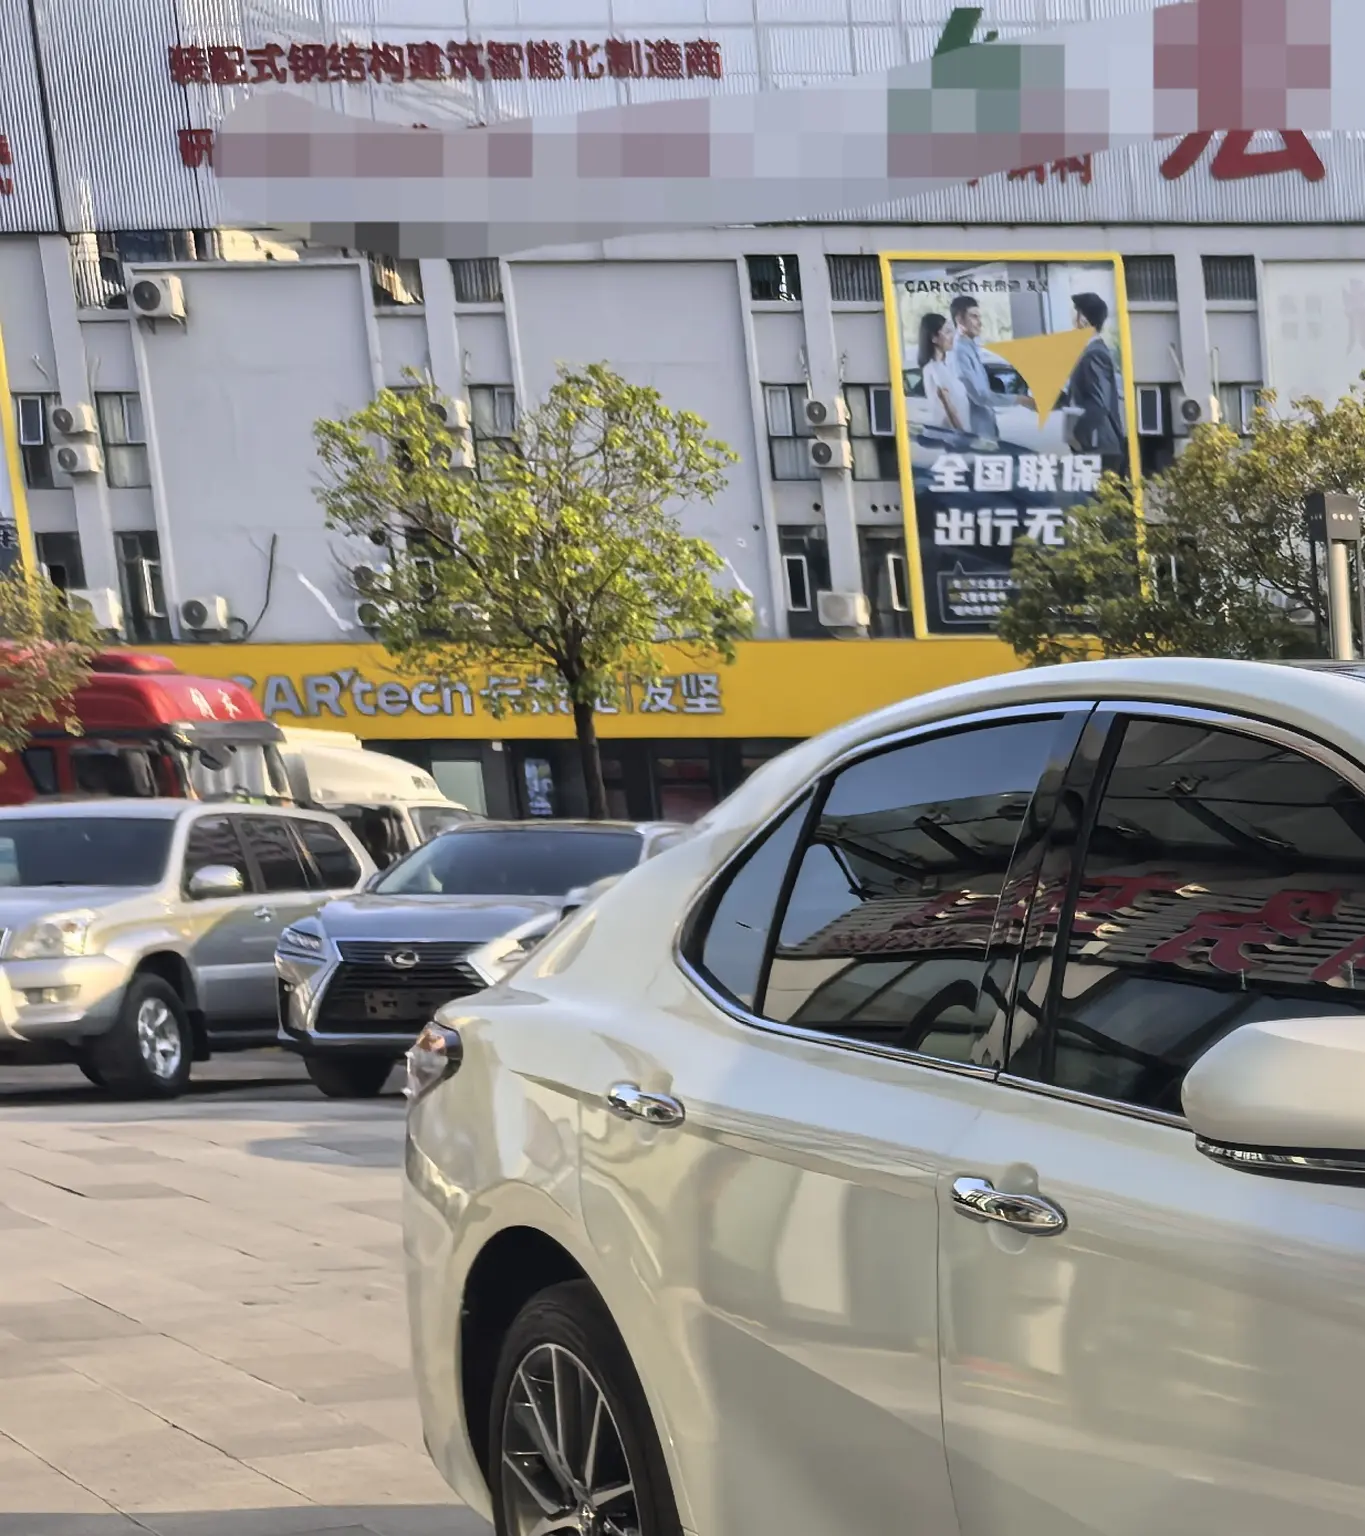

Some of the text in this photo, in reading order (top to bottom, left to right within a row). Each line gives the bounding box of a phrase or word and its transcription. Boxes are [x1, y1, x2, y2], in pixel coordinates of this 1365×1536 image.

[929, 454, 1101, 492] 全国联保
[934, 508, 1072, 546] 出行无
[639, 672, 724, 714] 友坚
